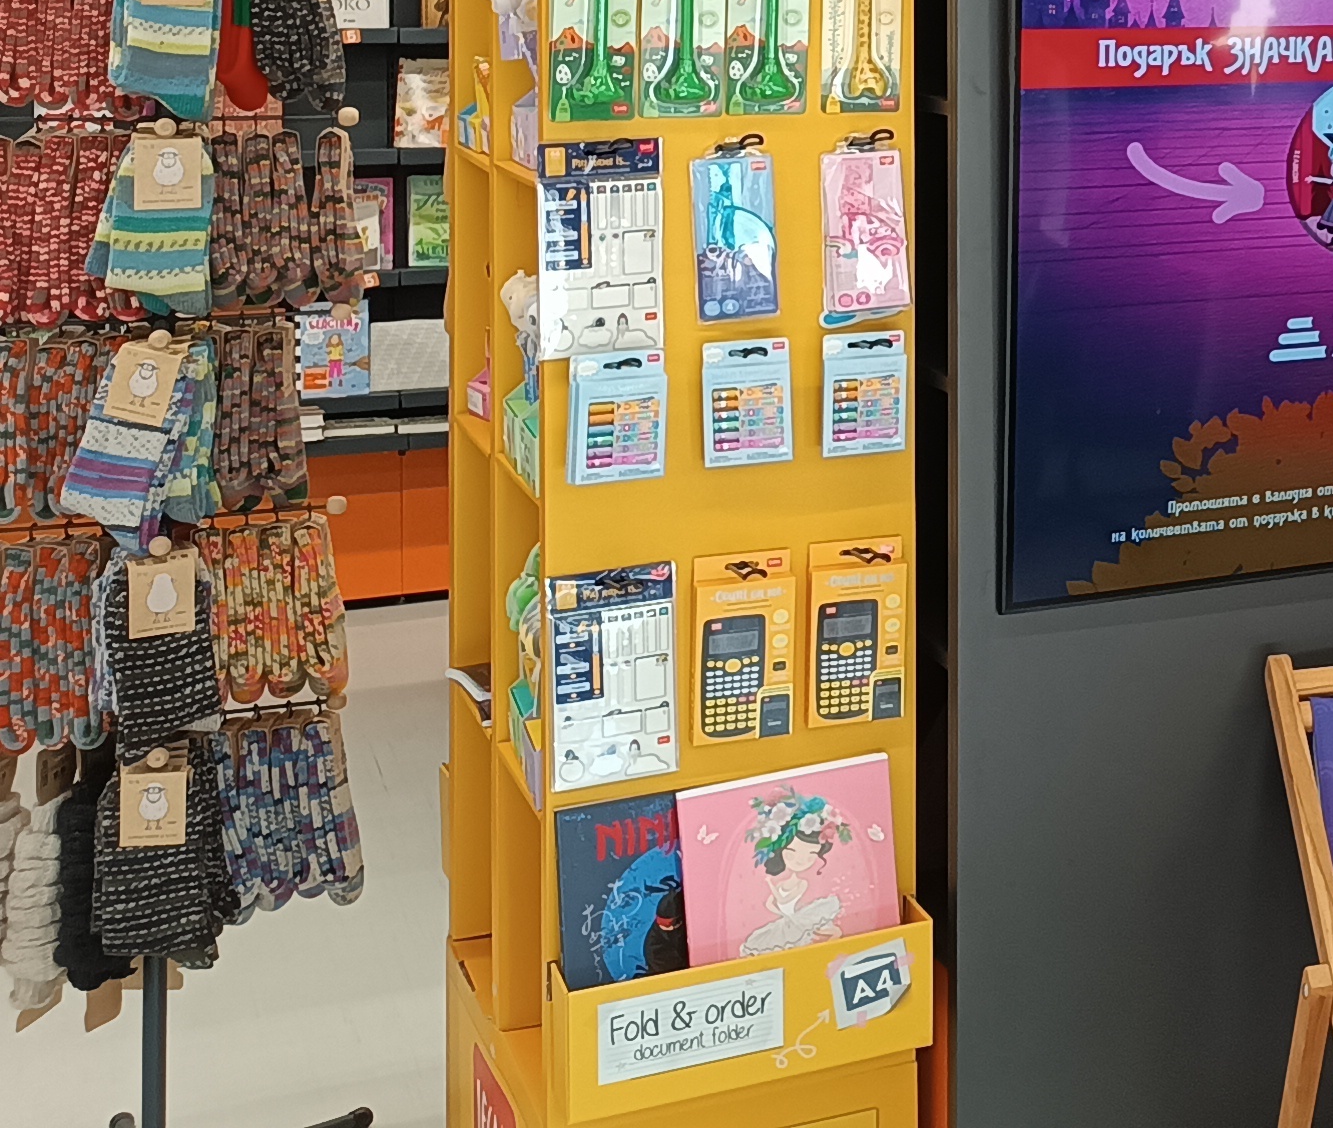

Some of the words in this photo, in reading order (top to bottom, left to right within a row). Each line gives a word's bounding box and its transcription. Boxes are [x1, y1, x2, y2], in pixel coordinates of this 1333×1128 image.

[1097, 38, 1212, 78] Подарък
[1111, 531, 1126, 543] на
[1229, 517, 1248, 528] от
[852, 969, 894, 1005] A4
[610, 1011, 659, 1047] Fold
[671, 1001, 697, 1031] &
[705, 989, 772, 1026] order
[634, 1033, 705, 1063] document
[712, 1022, 754, 1046] folder
